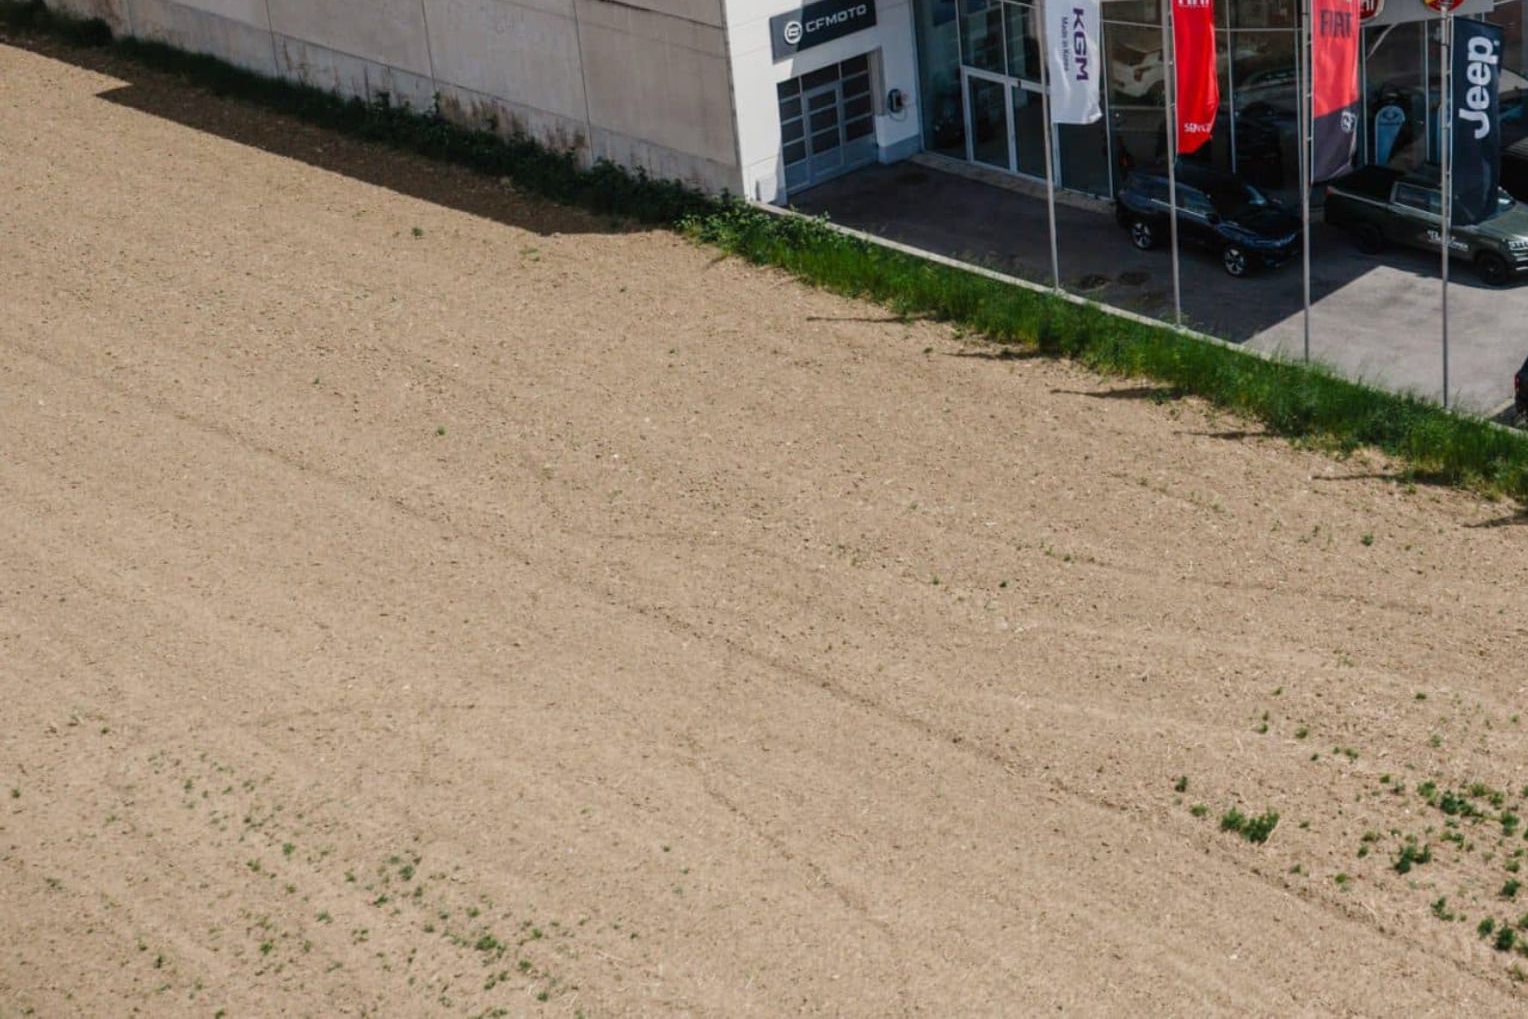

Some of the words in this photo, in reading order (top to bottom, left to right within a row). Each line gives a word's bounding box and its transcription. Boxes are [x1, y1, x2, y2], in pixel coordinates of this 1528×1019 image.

[805, 4, 867, 33] CFMOTO
[1073, 7, 1089, 81] KGM
[1320, 9, 1352, 39] FIAT
[1458, 36, 1498, 139] Jeep
